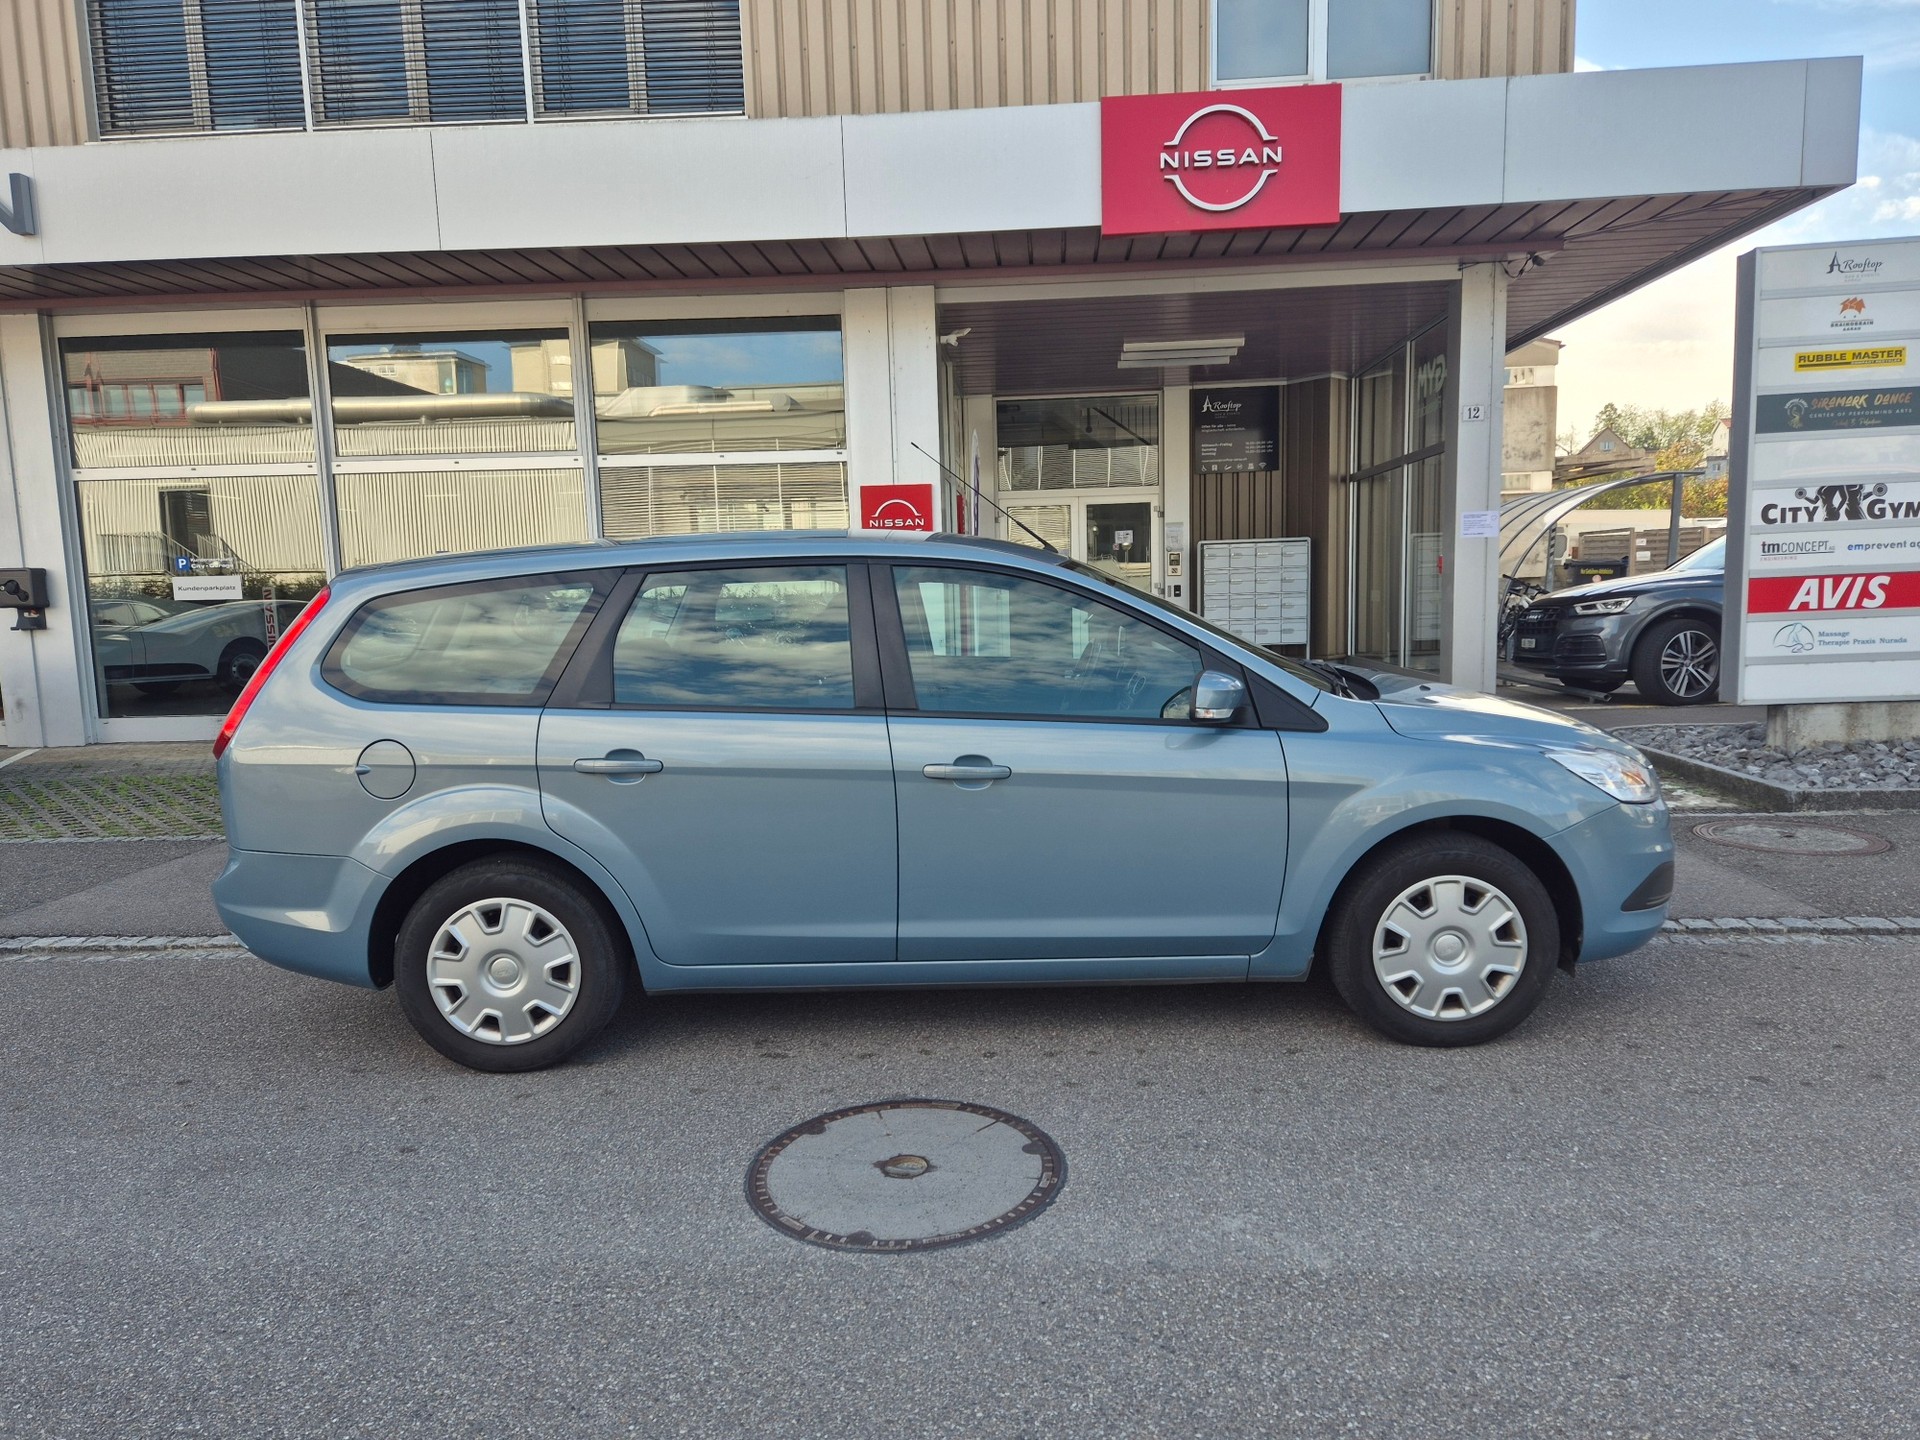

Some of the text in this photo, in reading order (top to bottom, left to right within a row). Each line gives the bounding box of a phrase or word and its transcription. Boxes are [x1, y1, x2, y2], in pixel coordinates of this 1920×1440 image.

[1160, 146, 1282, 169] NISSAN
[1843, 257, 1883, 273] Rooftop
[1798, 349, 1902, 363] RUBBLE MASTER
[1468, 406, 1480, 419] 12
[1761, 498, 1920, 525] CITY GYM
[869, 518, 925, 527] NISSAN
[1847, 540, 1907, 551] emprevent
[178, 558, 187, 569] P
[1788, 575, 1892, 611] AVIS
[1818, 639, 1850, 647] Therapie
